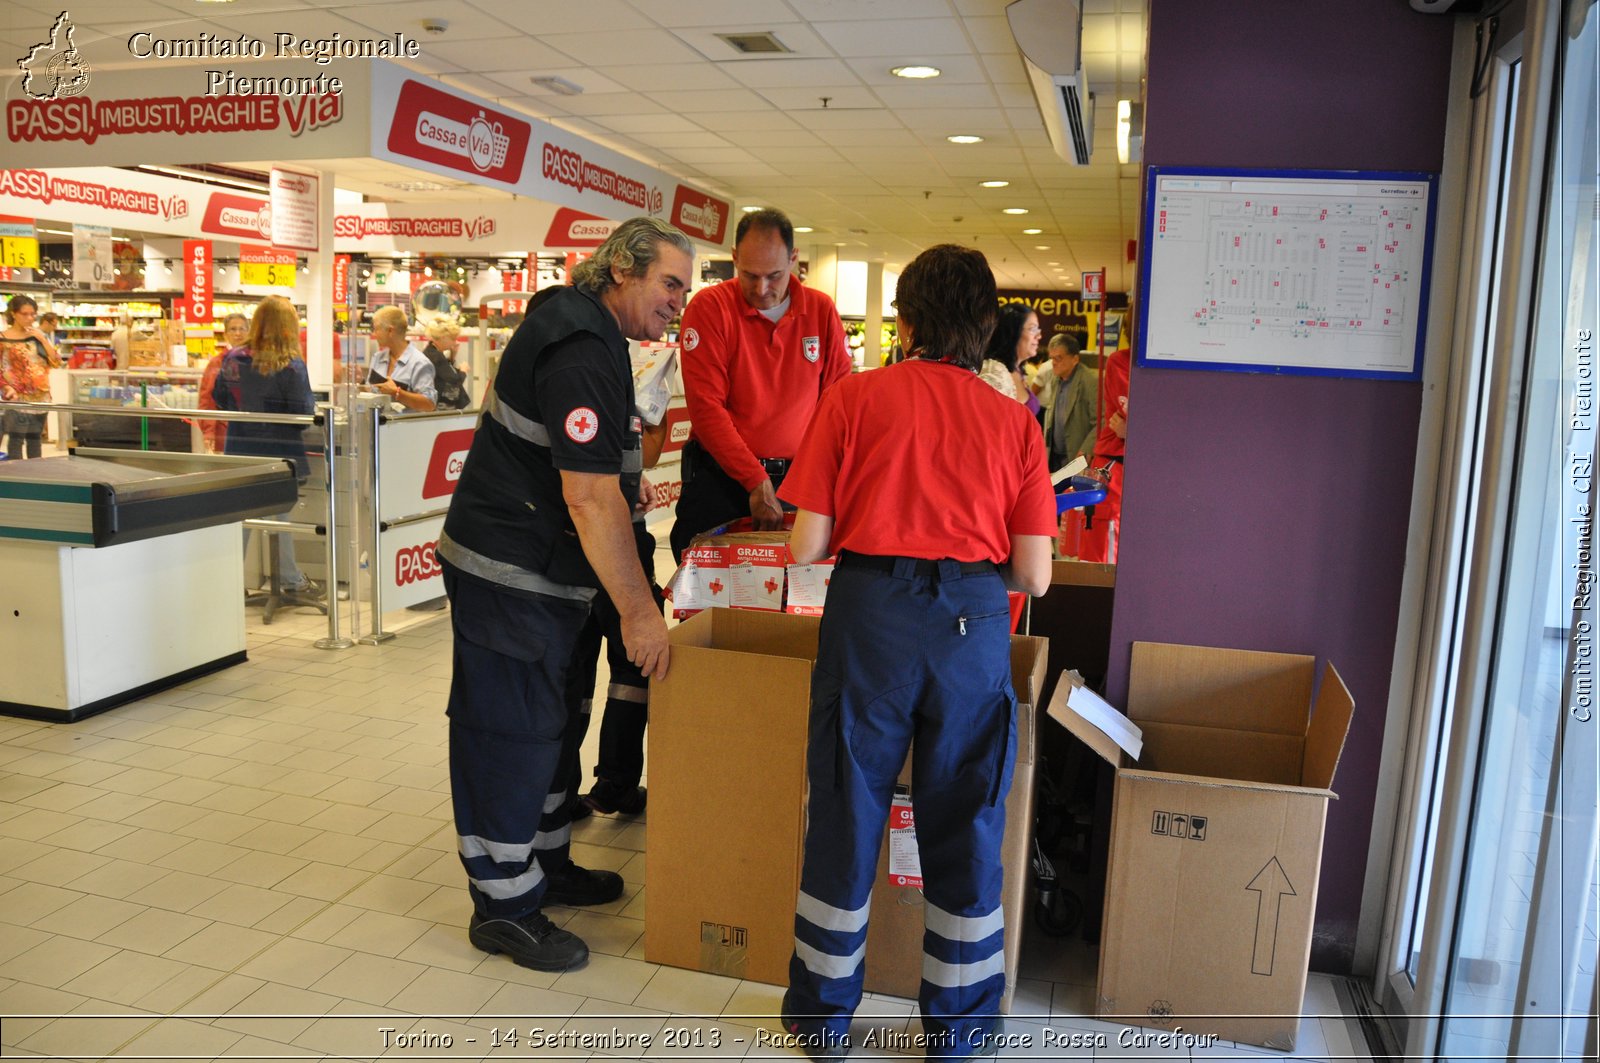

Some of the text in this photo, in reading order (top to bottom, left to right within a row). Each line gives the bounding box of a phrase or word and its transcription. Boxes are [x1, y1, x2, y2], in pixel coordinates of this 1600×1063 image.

[11, 86, 340, 136] PASSI, IMBUSTI, PAGHI E Via
[419, 118, 490, 156] Cassa e Via
[544, 147, 583, 186] PASSI,
[584, 169, 617, 196] IMBUSTI,
[617, 180, 639, 203] PAGHI
[646, 185, 662, 213] Via
[53, 181, 108, 204] IMBUSTI,
[110, 191, 148, 211] PAGHI
[160, 194, 187, 219] Via
[221, 211, 249, 225] Cassa
[250, 216, 257, 226] e
[365, 220, 412, 233] IMBUSTI,
[414, 220, 450, 233] PAGHI
[464, 215, 494, 239] Via
[572, 224, 609, 235] Cassa
[192, 245, 206, 318] Offerta
[267, 264, 276, 285] 5
[737, 547, 778, 558] GRAZIE.
